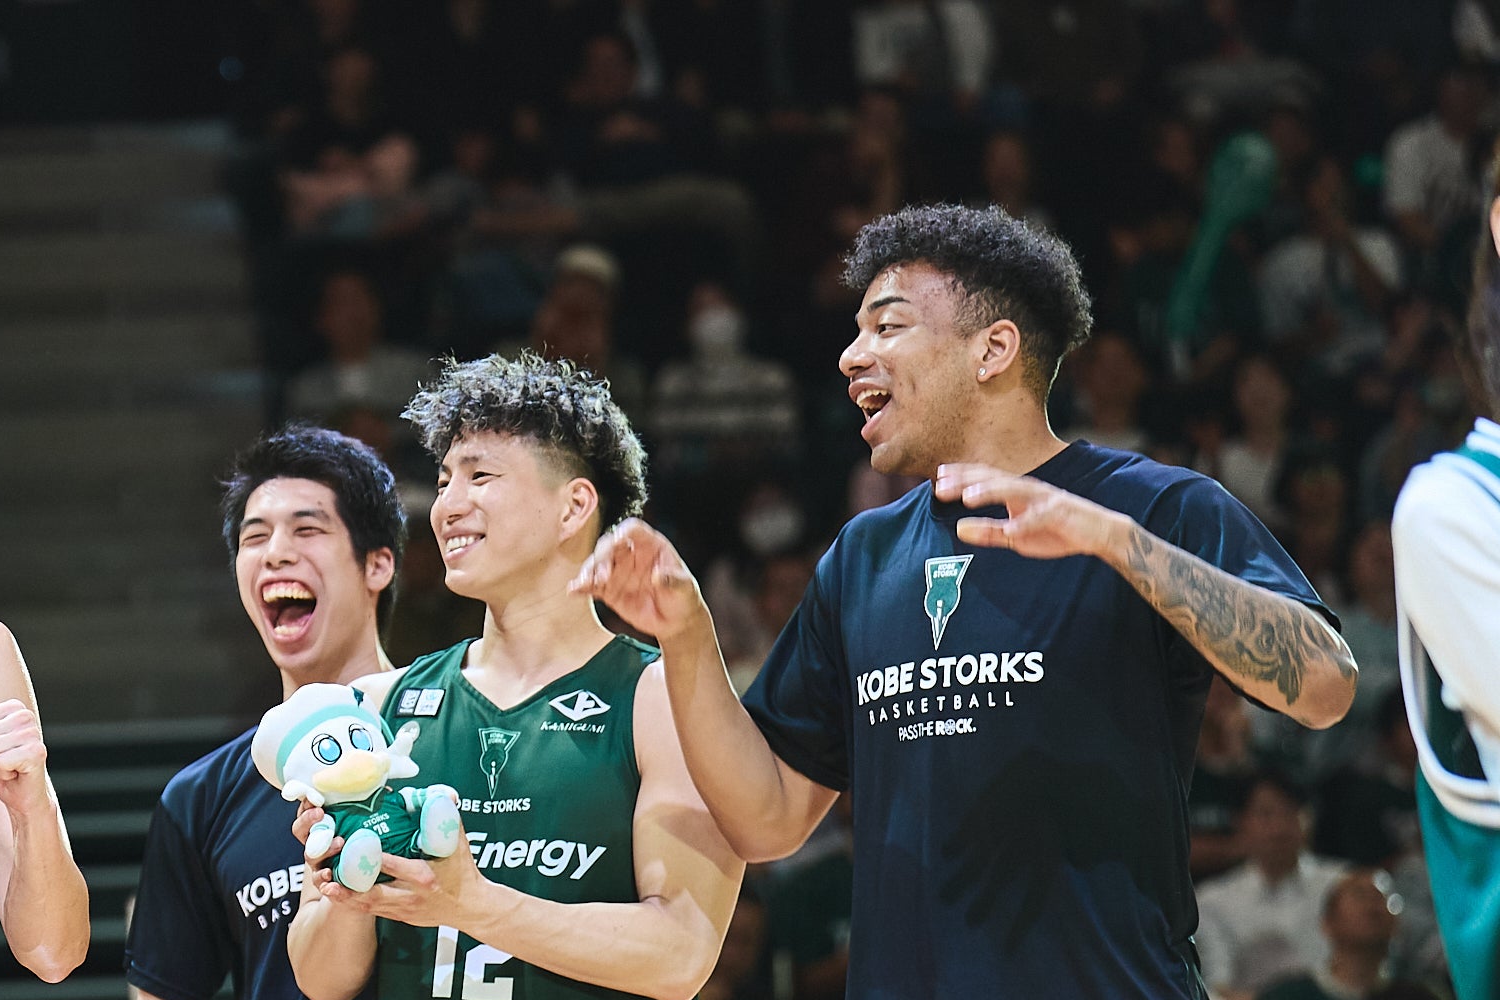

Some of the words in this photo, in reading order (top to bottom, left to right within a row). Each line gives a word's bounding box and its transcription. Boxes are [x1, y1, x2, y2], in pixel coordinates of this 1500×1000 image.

[856, 661, 915, 706] KOBE
[919, 652, 1045, 690] STORKS
[869, 691, 1015, 726] BASKETBALL
[540, 721, 606, 734] KAMIGUMI
[363, 813, 390, 828] STORKS
[457, 798, 481, 813] OBE
[482, 797, 531, 814] STORKS
[372, 821, 390, 835] 78
[465, 831, 607, 880] Energy
[236, 863, 305, 918] KOBE
[257, 900, 292, 930] BAS
